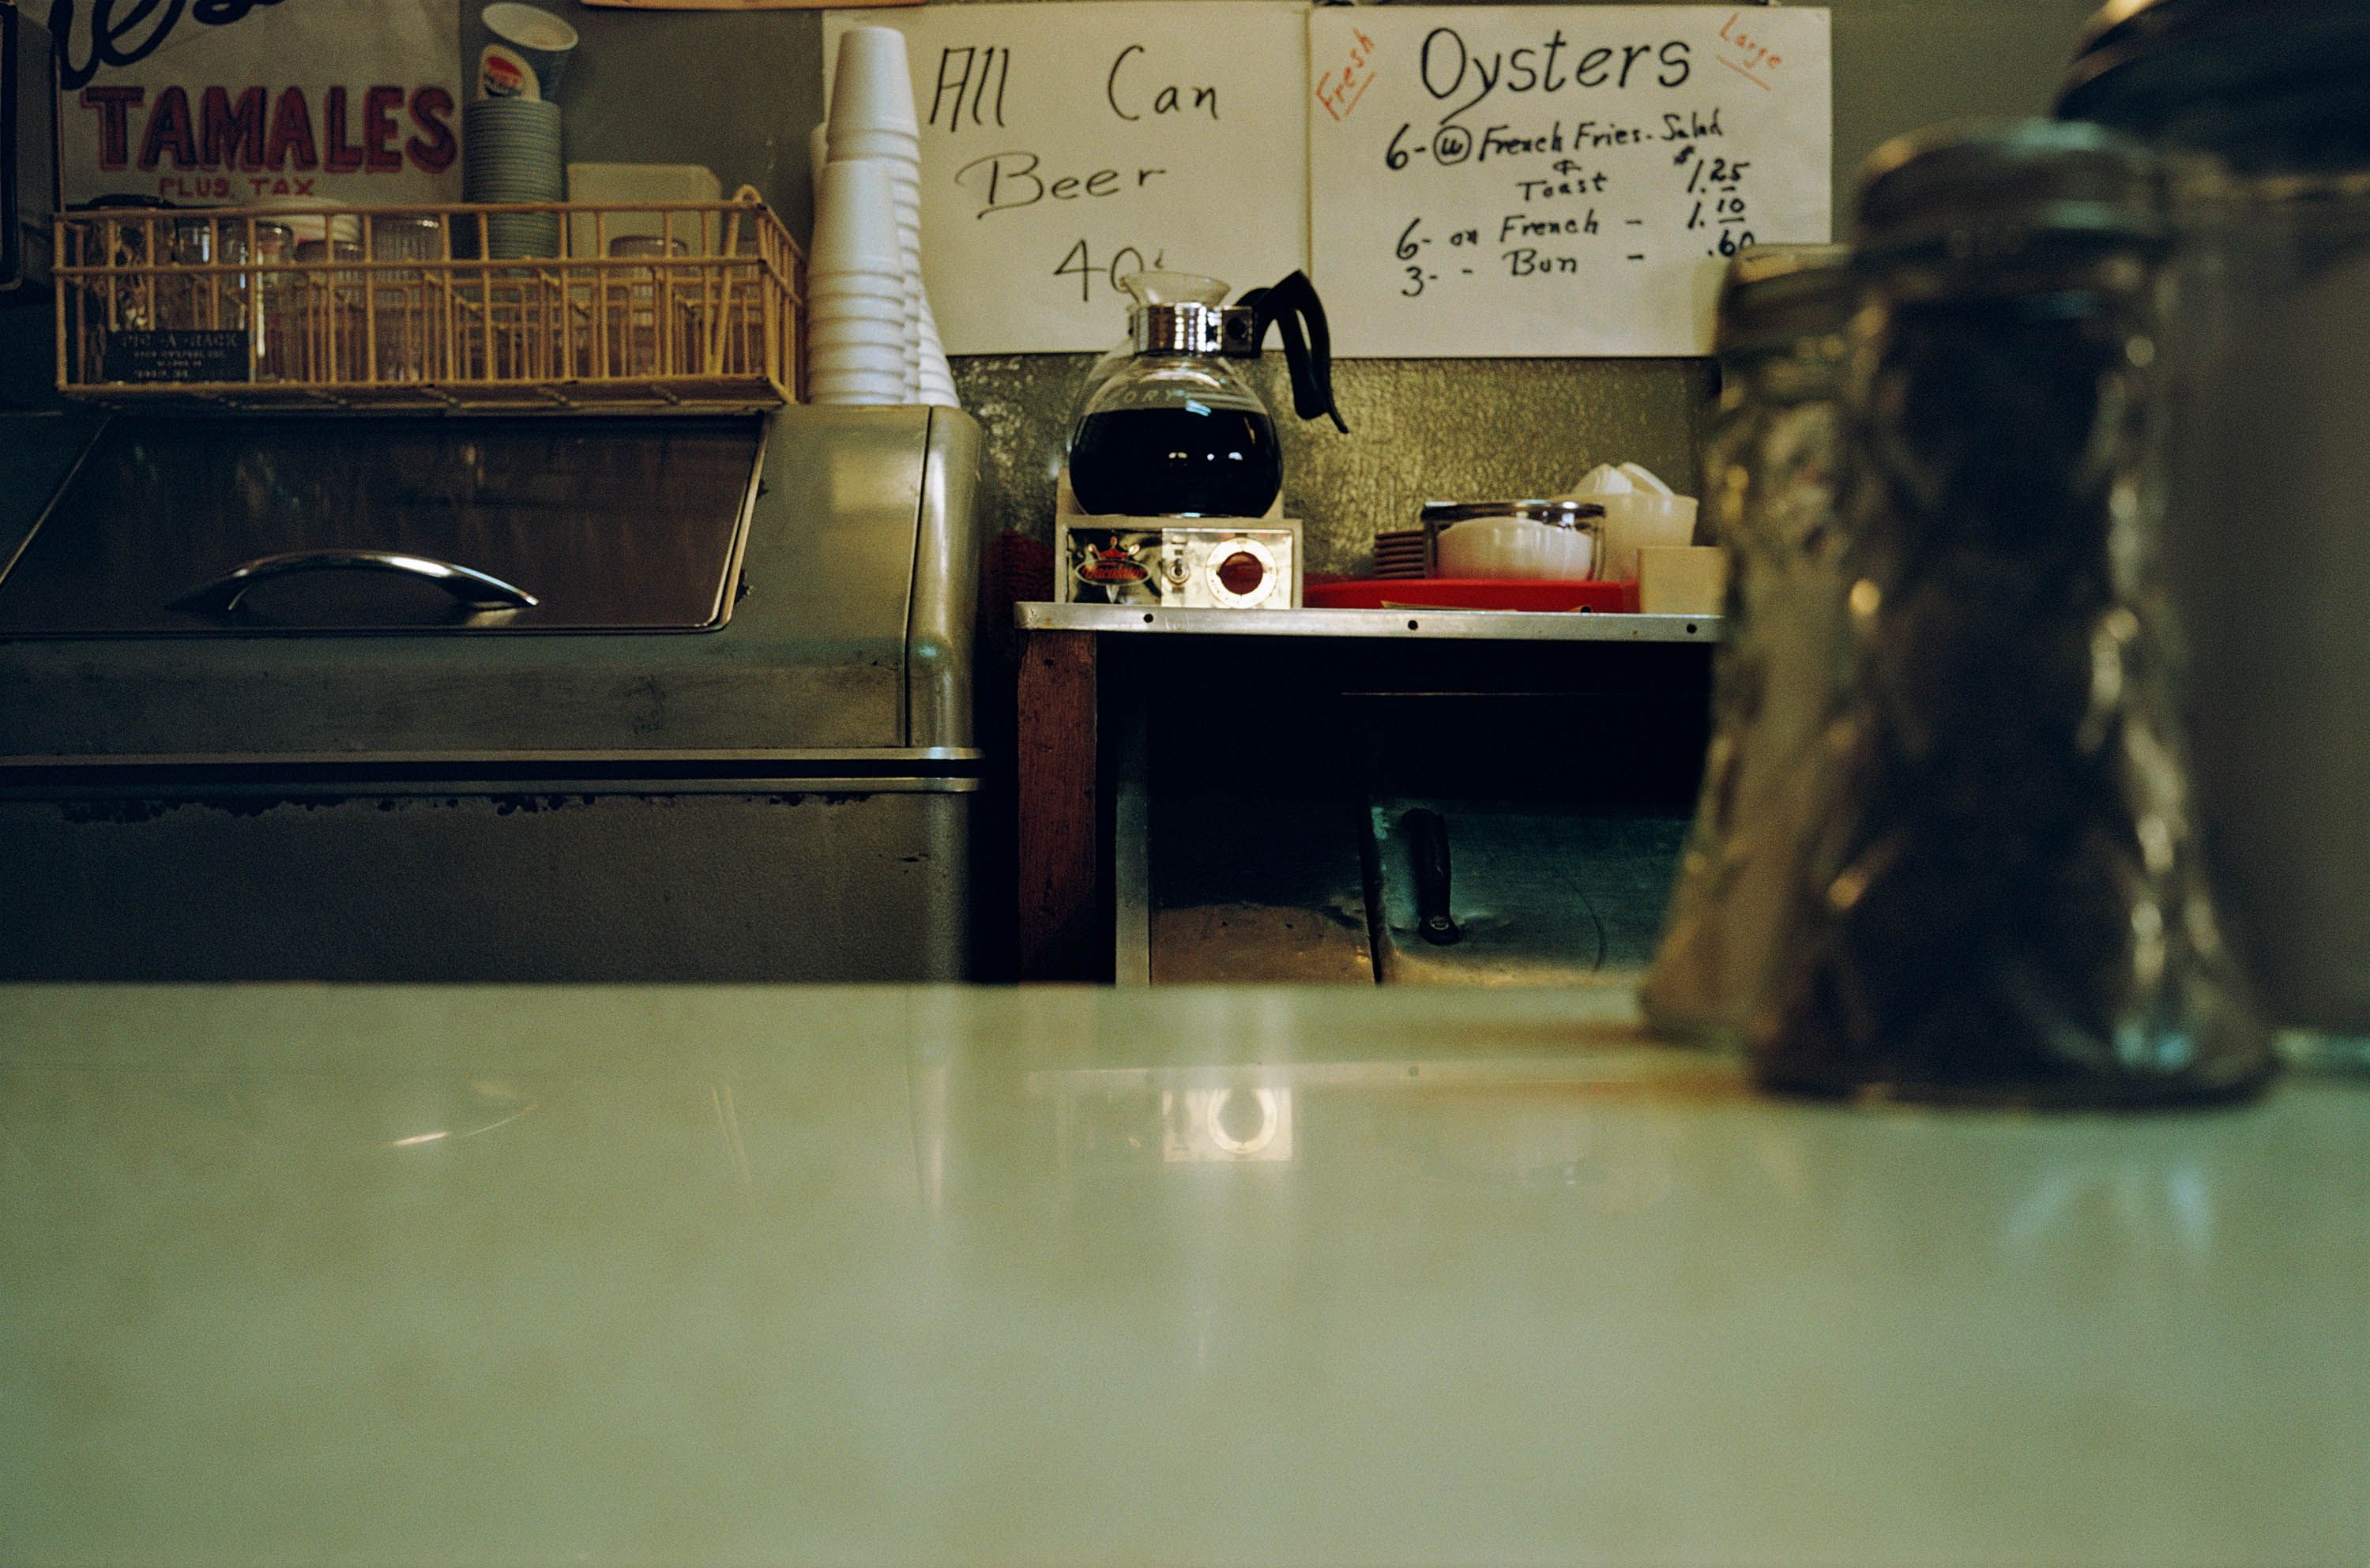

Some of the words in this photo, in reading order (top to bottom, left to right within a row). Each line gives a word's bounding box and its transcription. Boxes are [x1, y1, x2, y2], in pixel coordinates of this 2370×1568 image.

[1718, 13, 1784, 70] Large
[928, 45, 1010, 133] All
[1108, 44, 1218, 121] Can
[1317, 27, 1376, 121] Fresh
[1421, 27, 1691, 125] Oysters
[80, 85, 459, 175] TAMALES
[1478, 121, 1563, 162] French
[249, 177, 316, 197] TAX
[954, 151, 1167, 220] Beer
[1515, 171, 1608, 201] Toast
[1450, 229, 1479, 246] on
[1499, 209, 1601, 243] French
[1501, 247, 1578, 276] Bun
